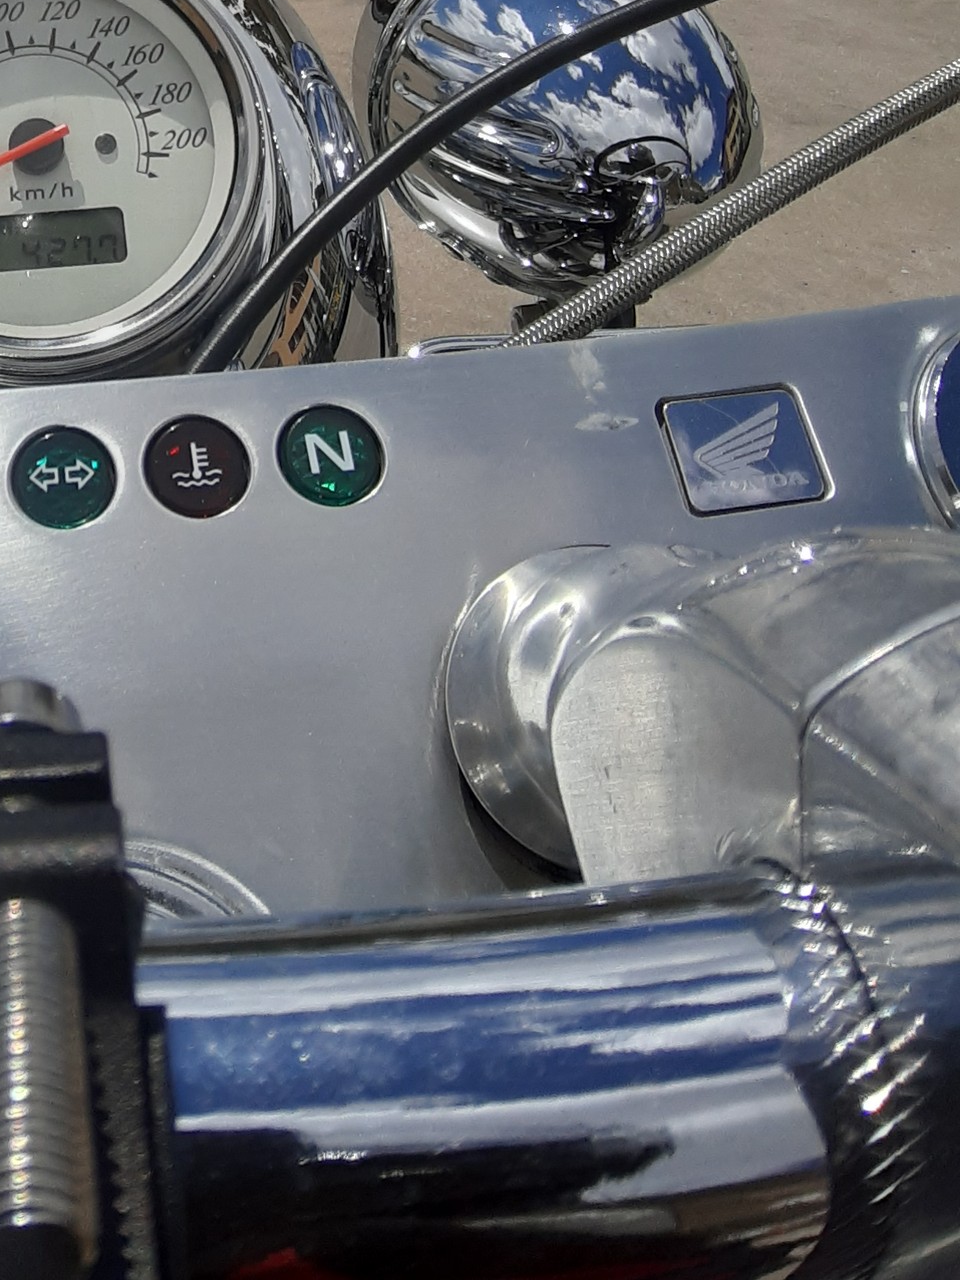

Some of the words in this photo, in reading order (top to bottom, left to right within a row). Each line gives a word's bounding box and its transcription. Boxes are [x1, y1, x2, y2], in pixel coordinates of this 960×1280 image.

[40, 0, 81, 20] 120
[87, 16, 130, 39] 140
[121, 43, 164, 66] 160
[148, 82, 193, 105] 180
[162, 127, 206, 150] 200
[9, 185, 74, 202] km/h
[304, 430, 355, 474] N
